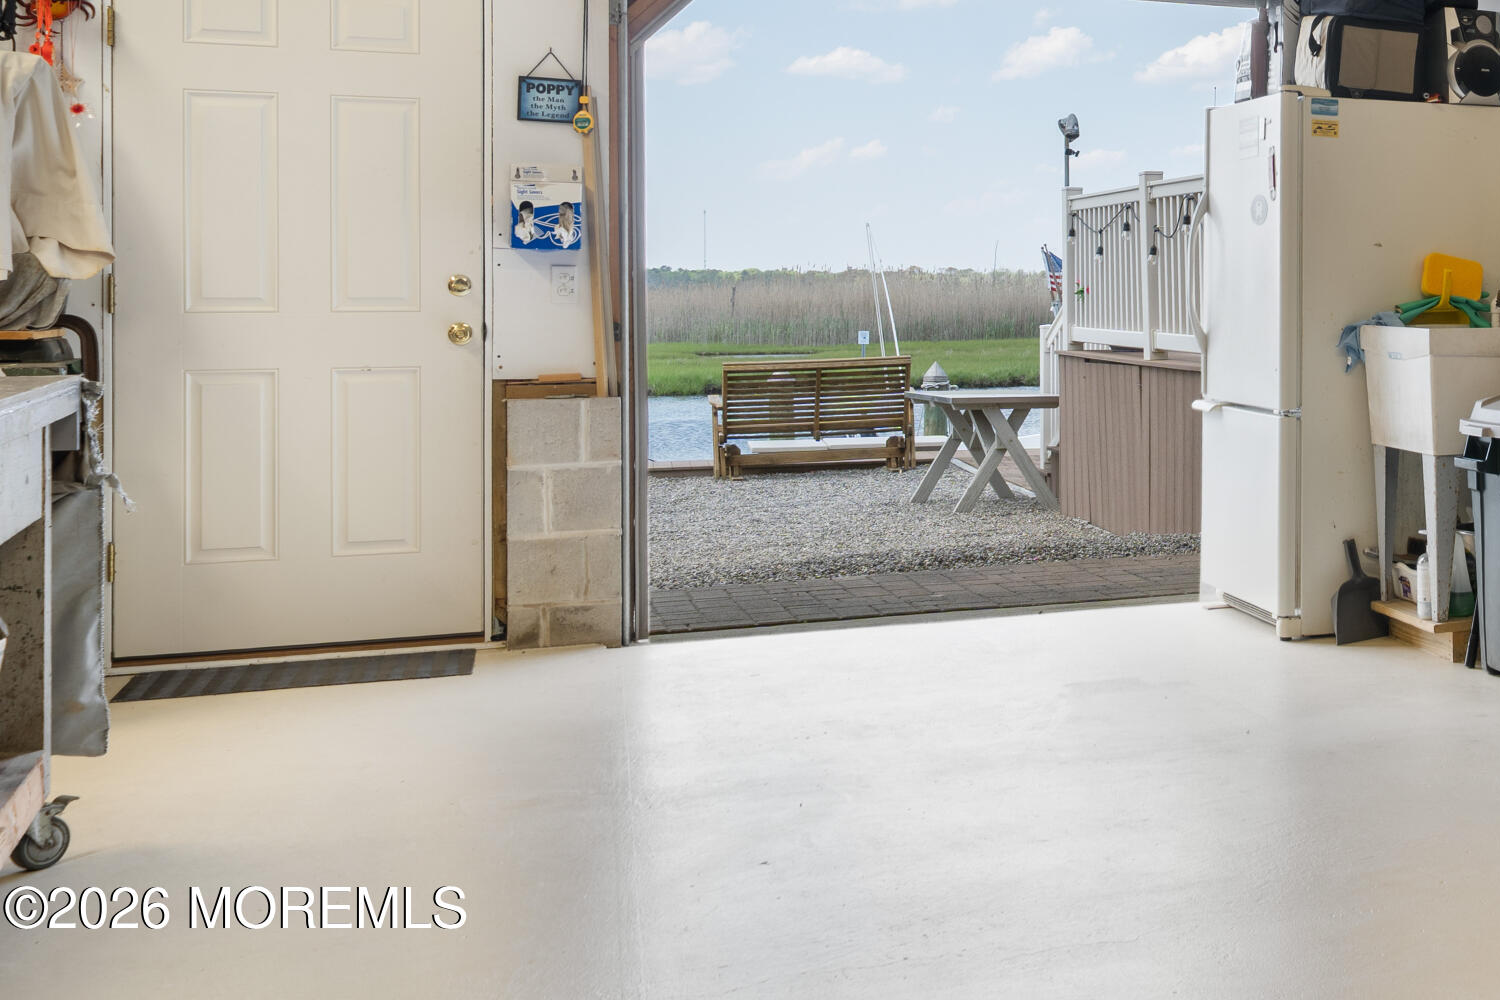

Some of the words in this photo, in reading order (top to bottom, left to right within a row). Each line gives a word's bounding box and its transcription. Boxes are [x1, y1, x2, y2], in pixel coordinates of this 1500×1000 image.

[526, 83, 574, 96] POPPY
[545, 103, 567, 112] Myth
[541, 111, 570, 119] Legend
